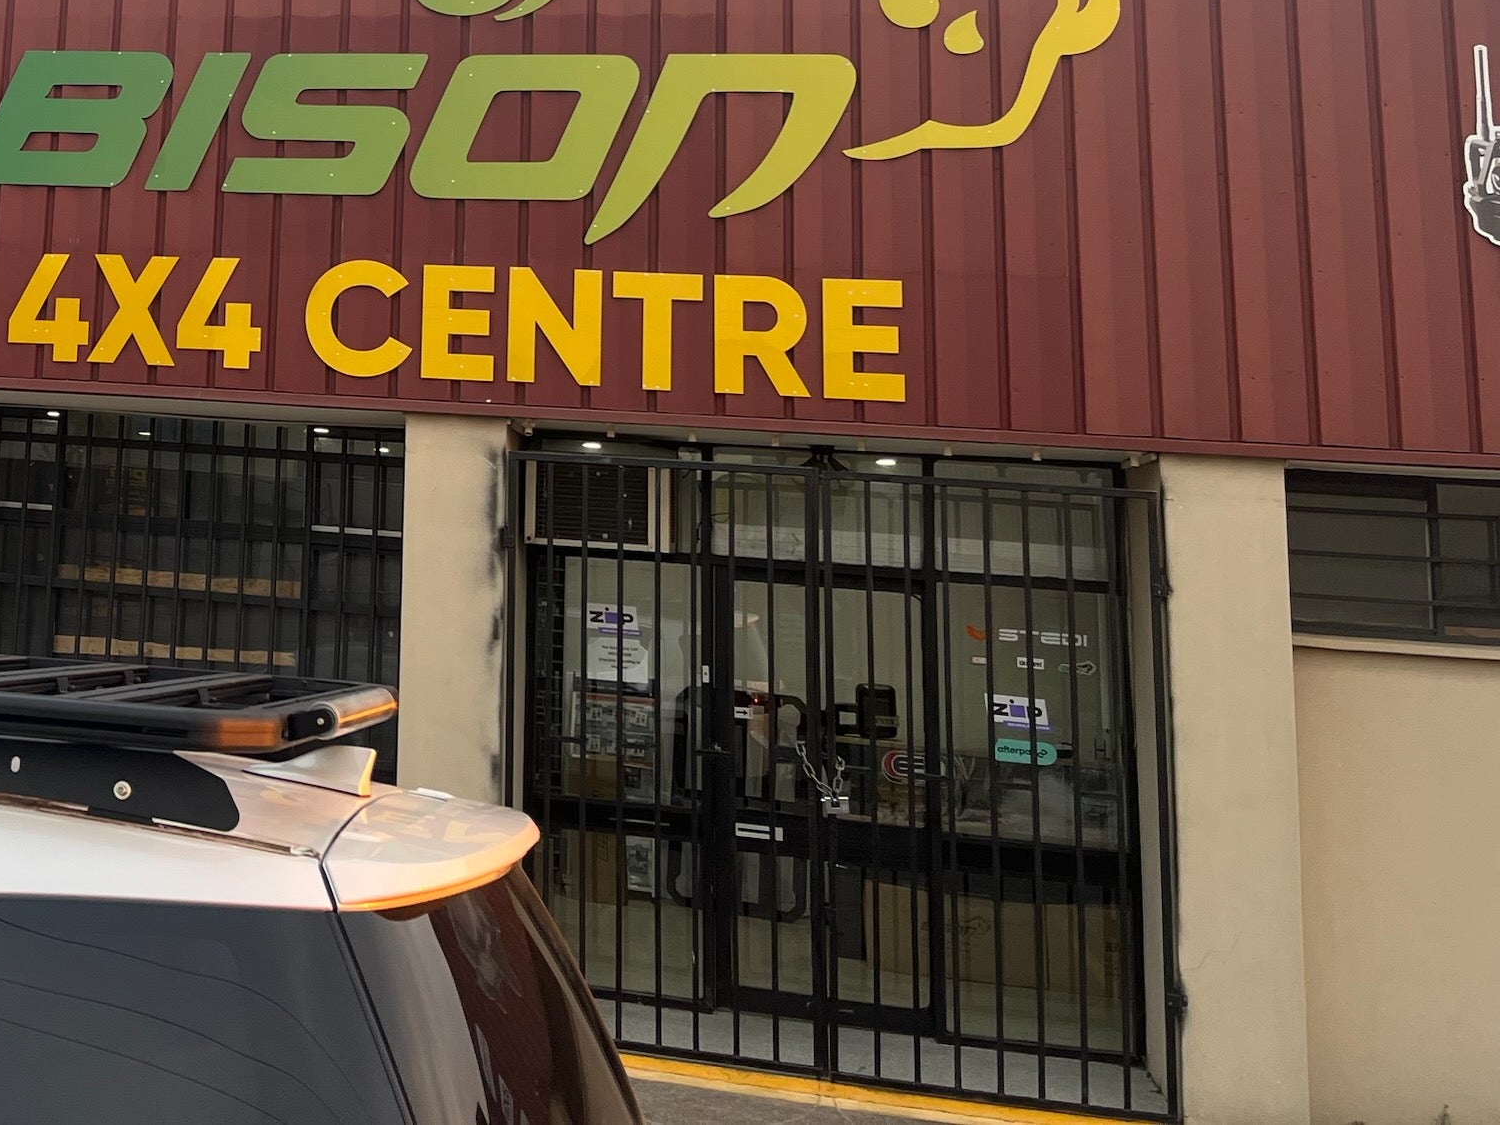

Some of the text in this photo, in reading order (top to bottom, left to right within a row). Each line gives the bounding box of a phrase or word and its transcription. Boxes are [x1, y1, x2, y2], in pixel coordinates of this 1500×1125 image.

[7, 252, 906, 402] 4X4 CENTRE
[997, 746, 1037, 757] afterpa
